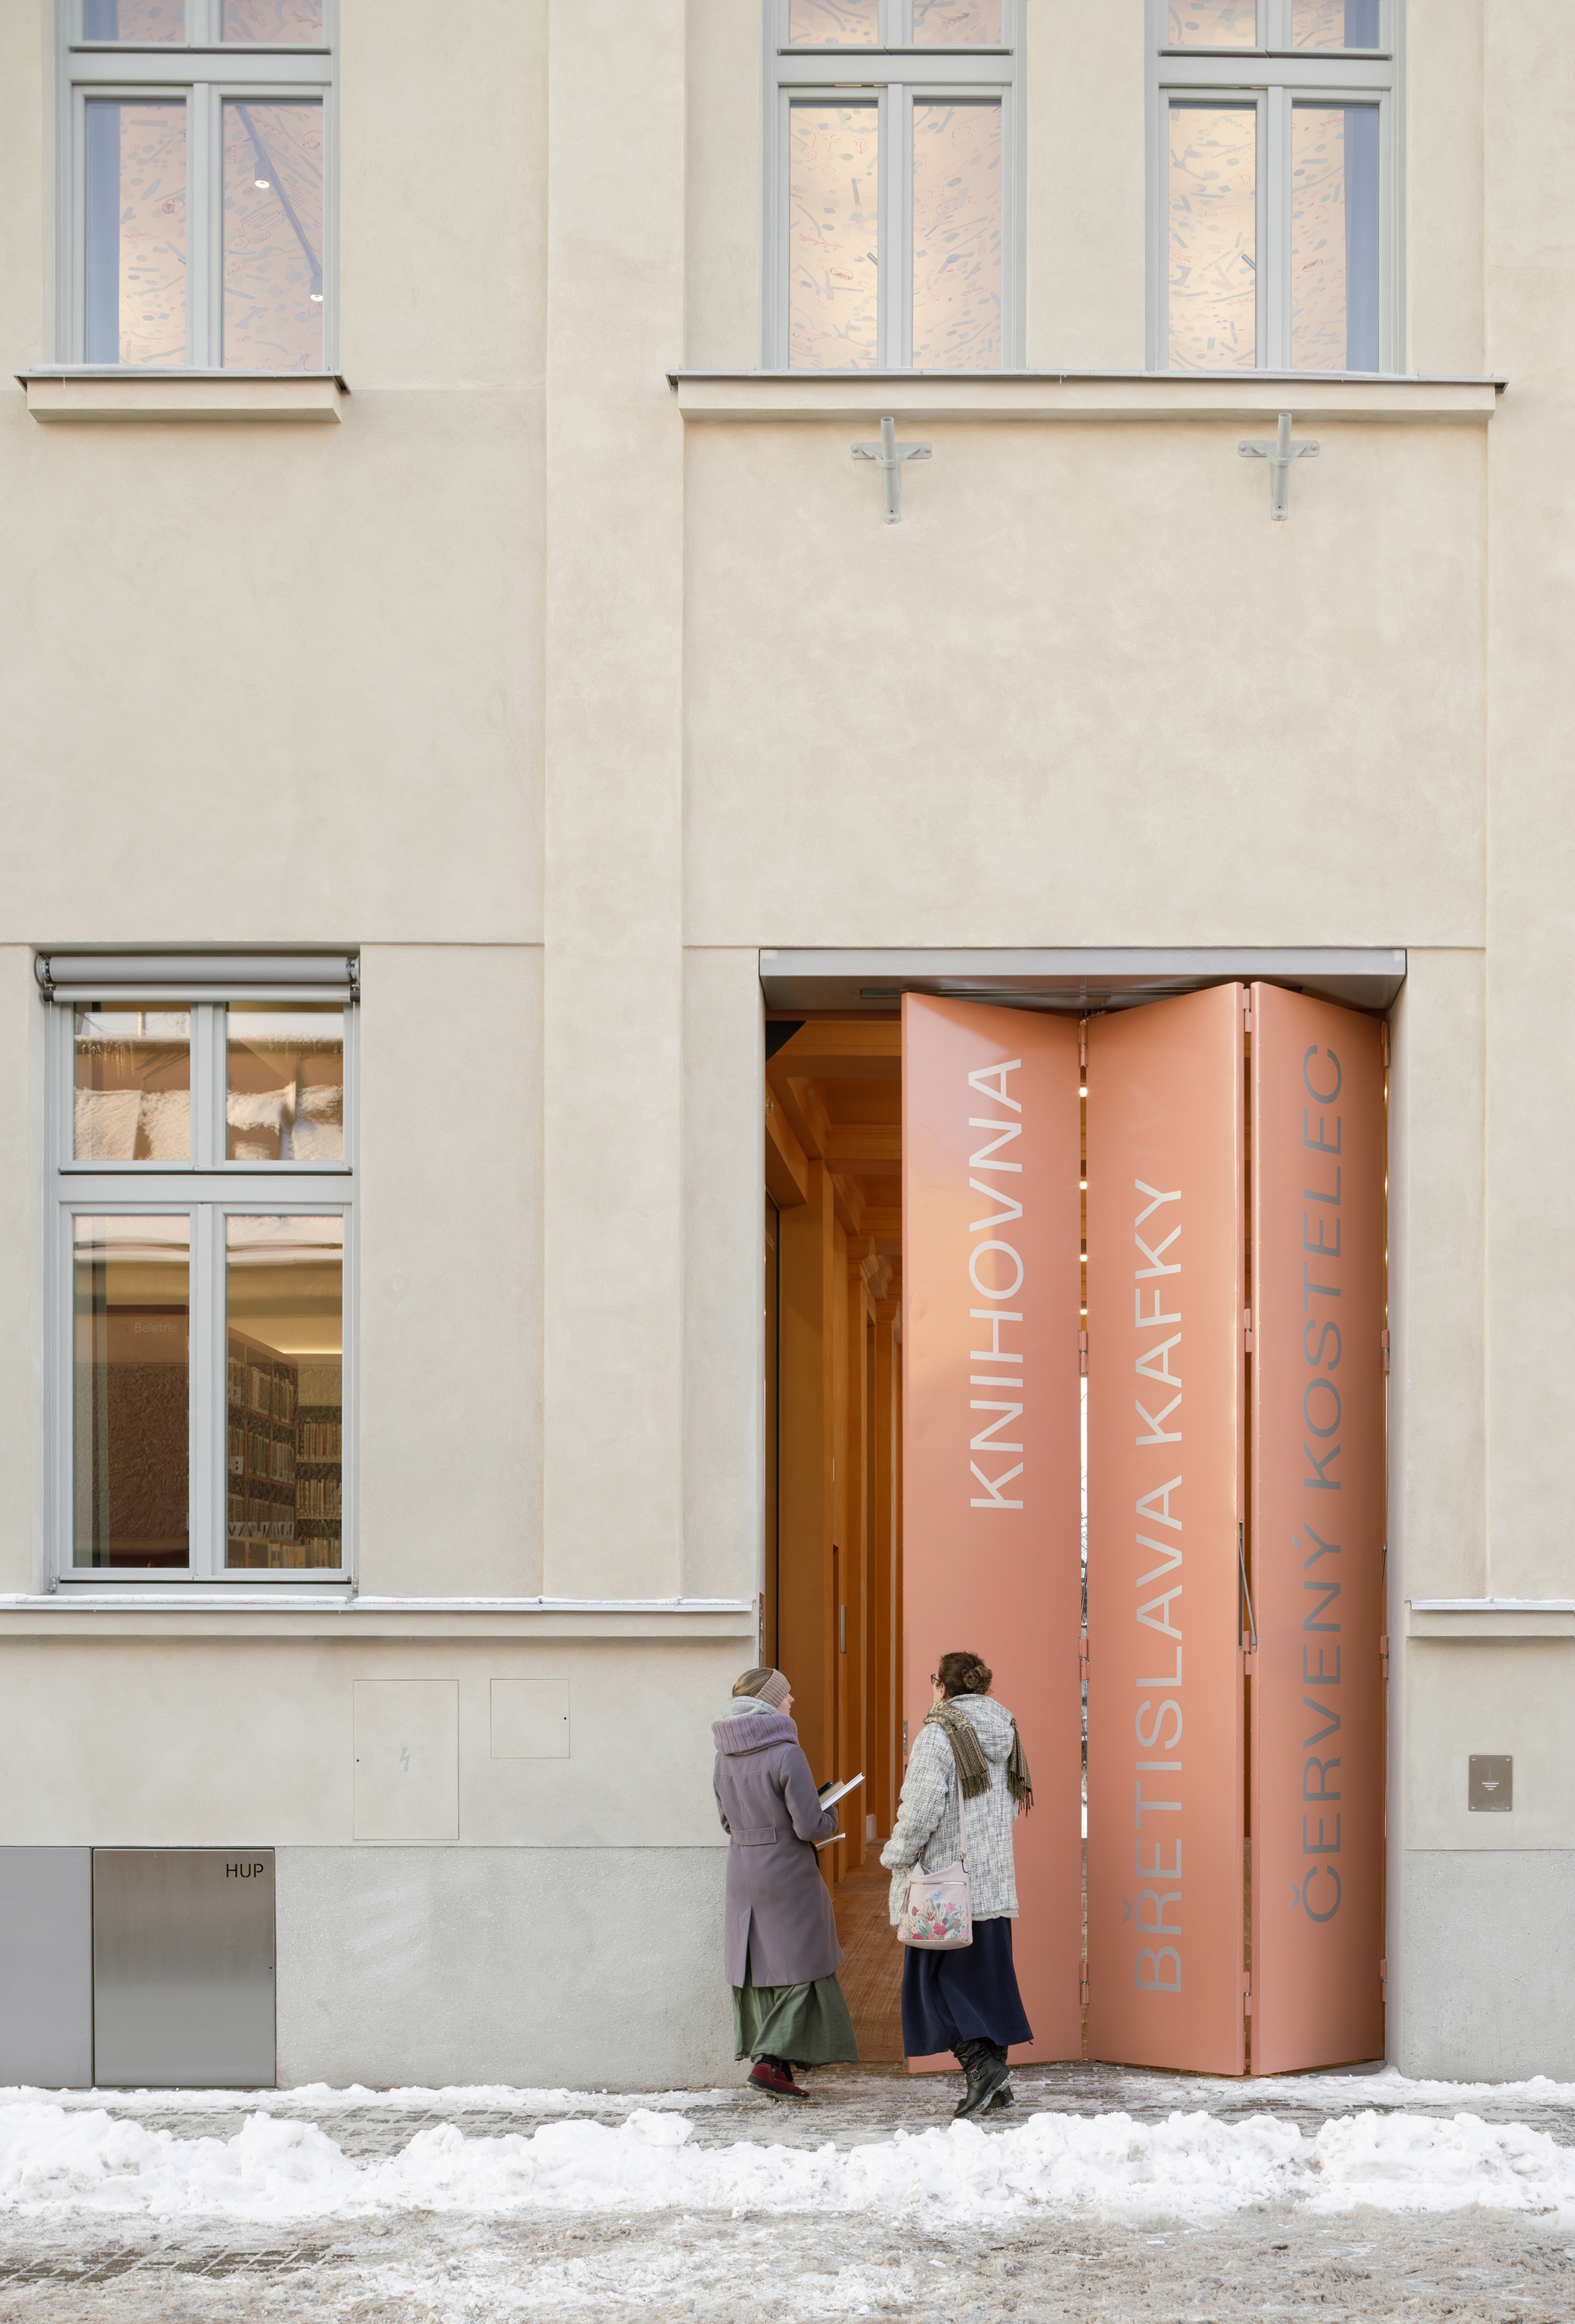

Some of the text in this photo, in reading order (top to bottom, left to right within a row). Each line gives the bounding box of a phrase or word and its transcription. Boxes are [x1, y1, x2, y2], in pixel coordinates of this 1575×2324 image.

[135, 1322, 177, 1333] Beletrie
[967, 1058, 1024, 1510] KNIHOVNA
[1291, 1044, 1342, 1923] ČERVENÝ KOSTELEC
[1121, 1178, 1183, 1993] BŘETISLAVA KAFKY
[226, 1863, 264, 1878] HUP
